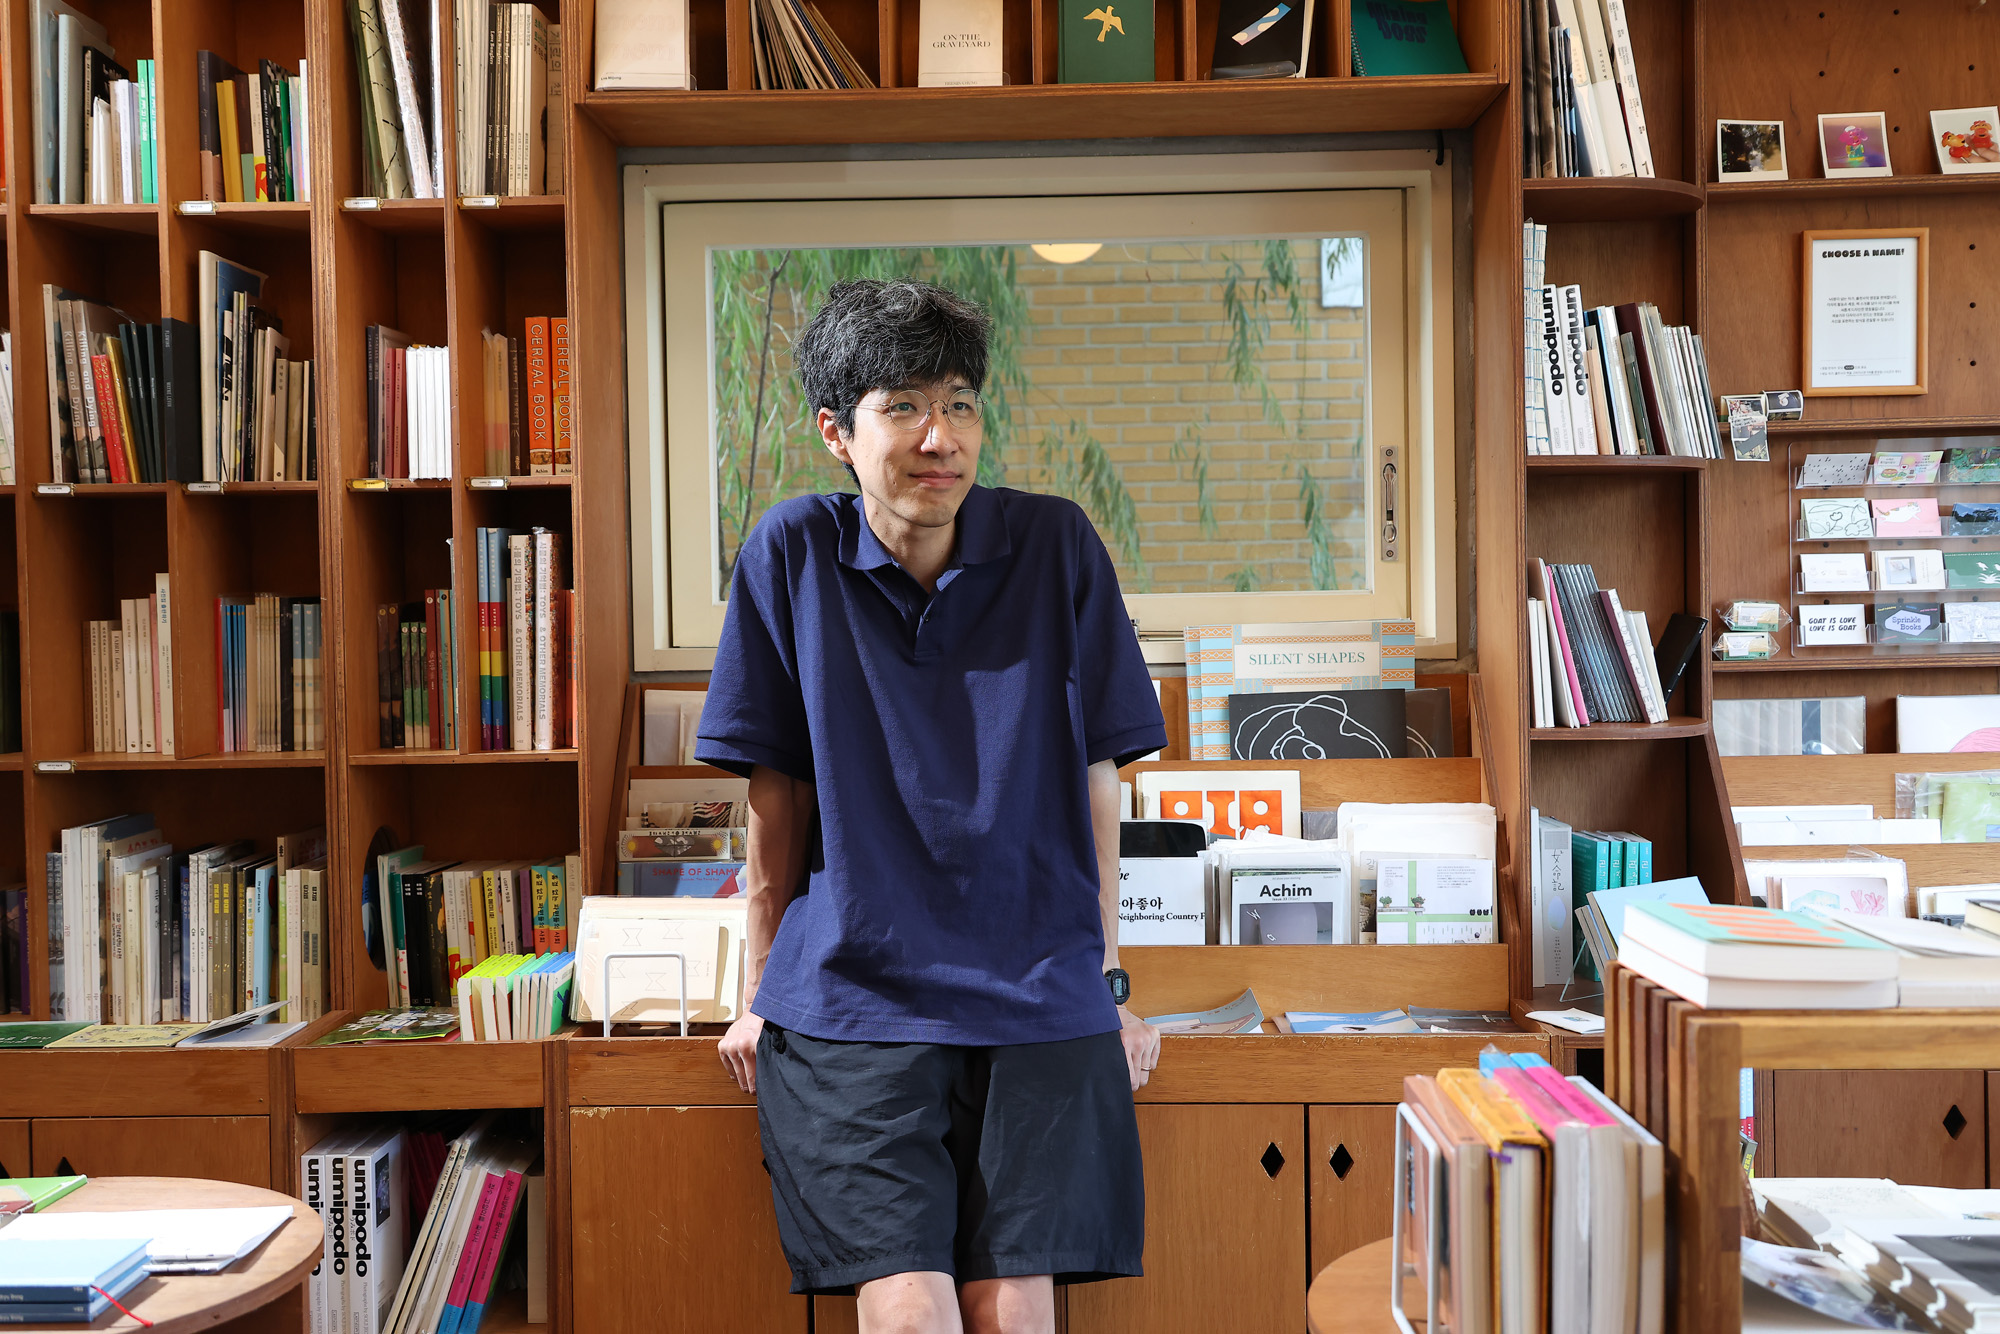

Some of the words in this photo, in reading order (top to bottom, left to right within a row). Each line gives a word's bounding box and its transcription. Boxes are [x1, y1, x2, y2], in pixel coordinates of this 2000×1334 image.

[1822, 250, 1861, 259] CHOOSE
[1863, 249, 1870, 257] A
[1872, 248, 1905, 257] NAME!
[64, 330, 74, 365] Killing
[78, 330, 88, 365] Killing
[530, 324, 544, 389] CEREAL
[556, 324, 570, 389] CEREAL
[1542, 287, 1565, 397] umipodo
[1565, 287, 1589, 397] umipodo
[69, 371, 78, 390] and
[83, 371, 93, 390] and
[71, 397, 81, 428] Dying
[86, 397, 97, 428] Dying
[533, 394, 547, 441] BOOK
[558, 394, 572, 441] BOOK
[515, 596, 523, 620] TOYS
[539, 595, 547, 619] TOYS
[1891, 616, 1922, 625] Sprinkle
[515, 637, 523, 667] OTHER
[539, 635, 547, 665] OTHER
[1249, 653, 1305, 666] SILENT
[1307, 650, 1366, 665] SHAPES
[515, 668, 524, 721] MEMORIALS
[539, 667, 547, 720] MEMORIALS
[652, 868, 685, 876] SHAPE
[688, 868, 702, 876] OF
[705, 867, 739, 876] SHAME
[1118, 896, 1163, 911] 아좋아
[1259, 883, 1312, 898] Achim
[1118, 912, 1165, 923] Neighboring
[1165, 912, 1199, 922] Country
[539, 930, 546, 943] 사회
[554, 931, 561, 944] 사회
[330, 1157, 349, 1275] umipodo
[352, 1159, 372, 1277] umipodo
